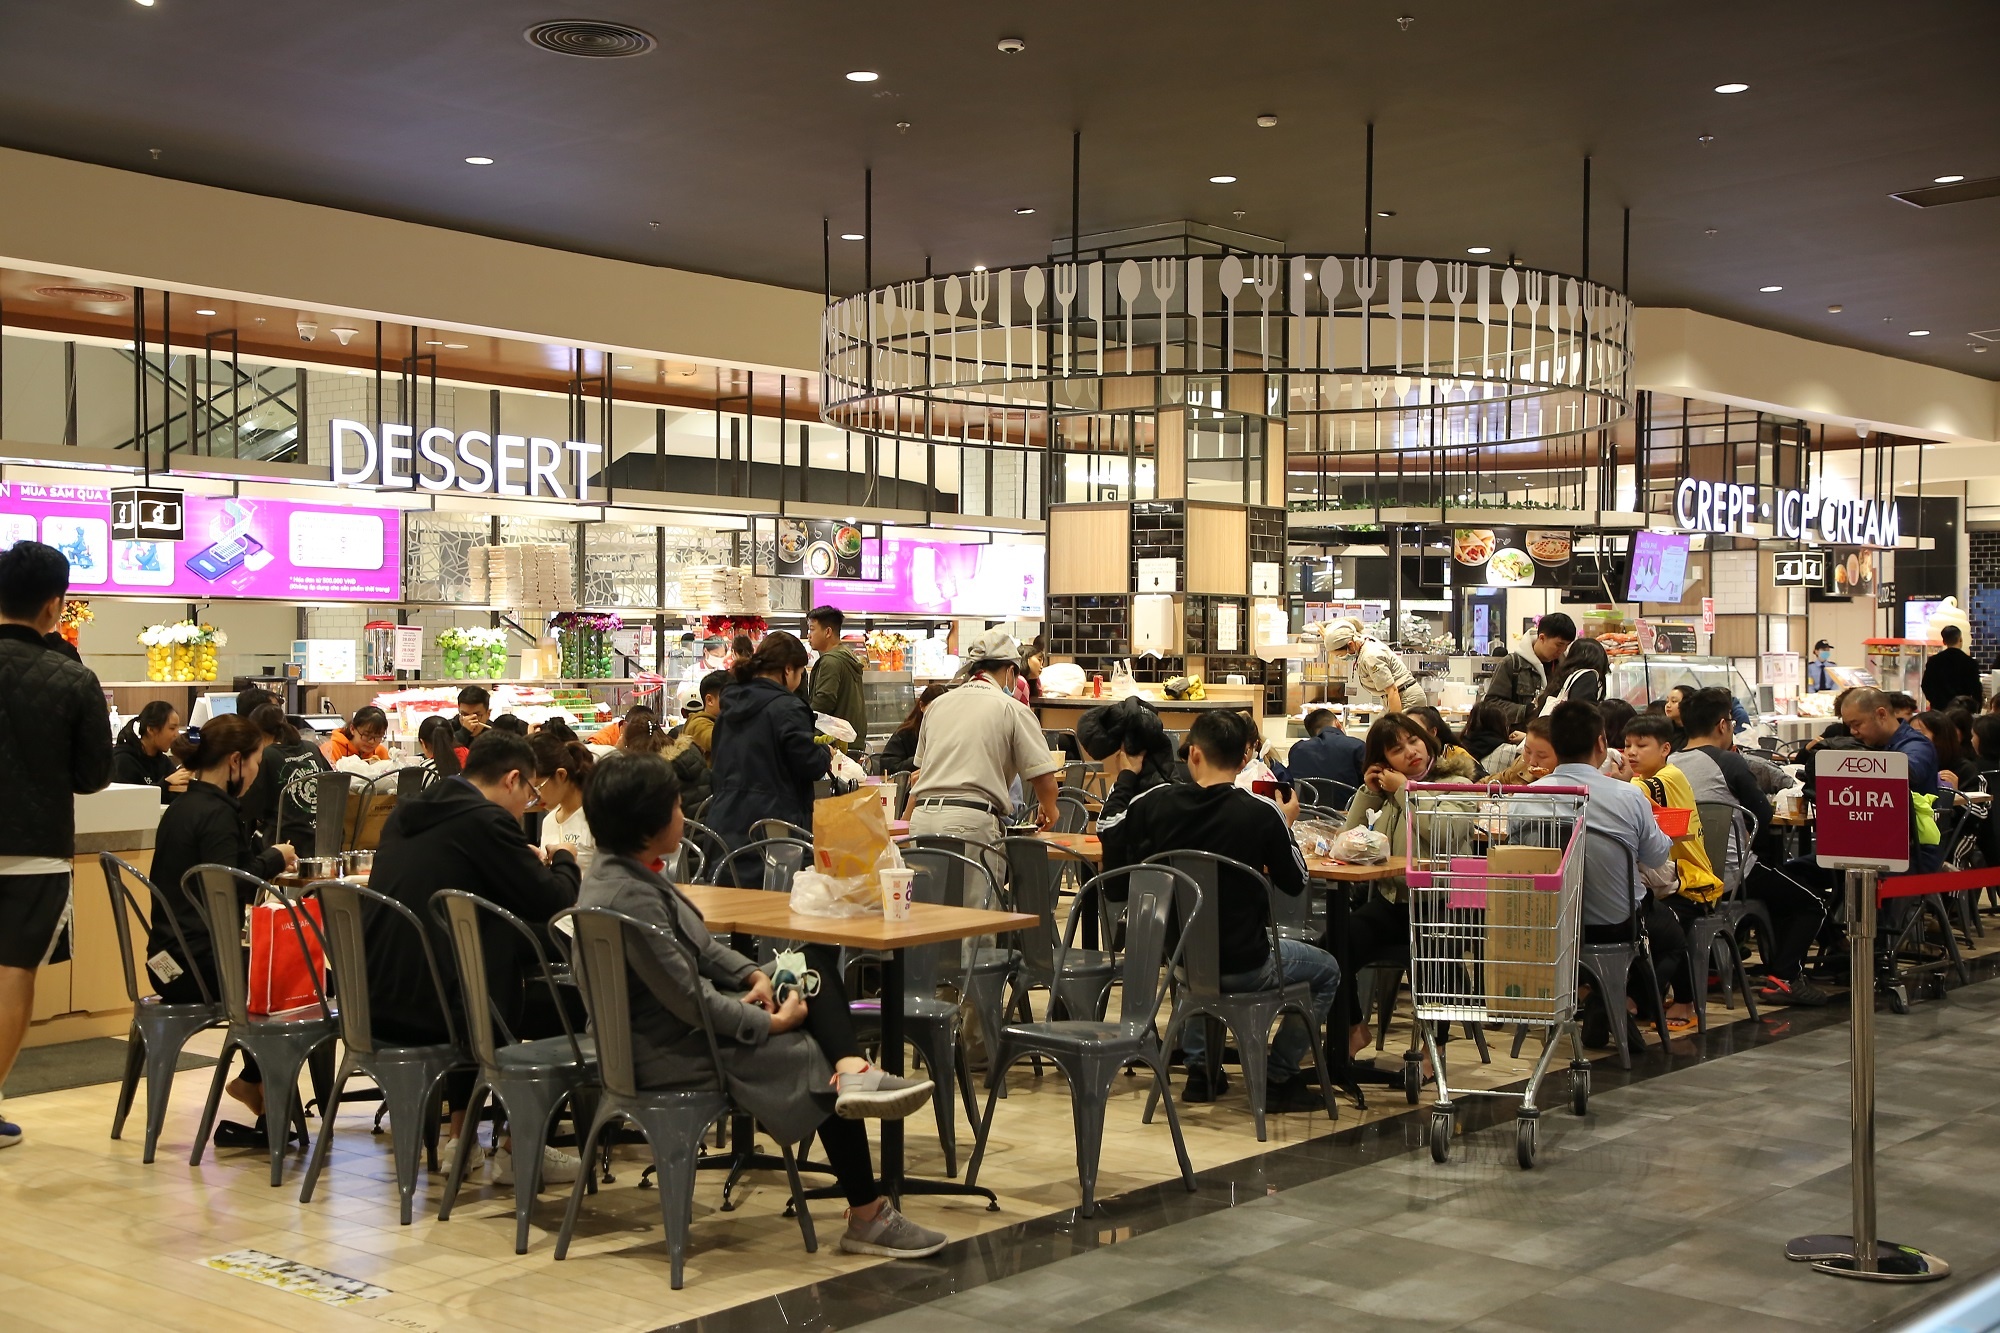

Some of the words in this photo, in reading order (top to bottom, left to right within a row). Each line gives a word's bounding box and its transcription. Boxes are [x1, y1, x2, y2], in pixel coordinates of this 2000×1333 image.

[329, 418, 603, 501] DESSERT
[1675, 477, 1757, 535] CREPE
[1776, 490, 1813, 540] ICE
[1818, 496, 1900, 547] CREAM
[1828, 784, 1861, 808] LỐI
[1866, 791, 1895, 809] RA
[1848, 811, 1875, 822] EXIT
